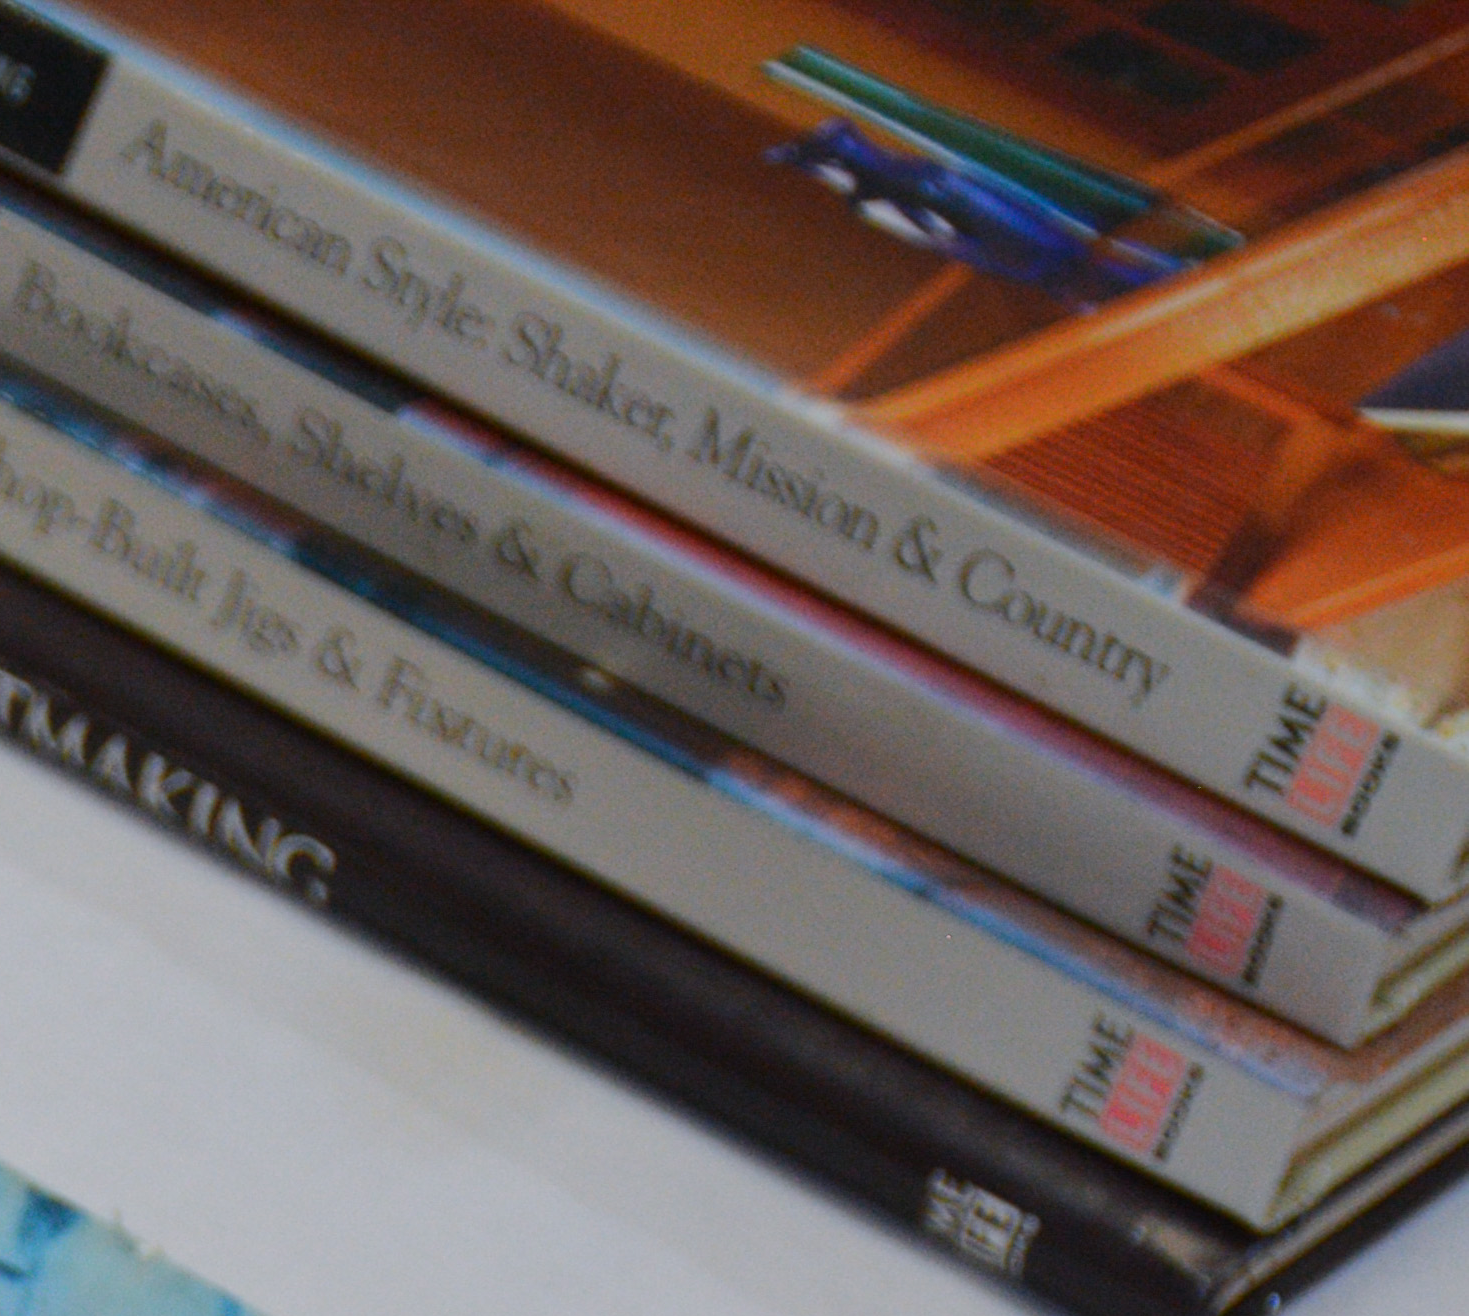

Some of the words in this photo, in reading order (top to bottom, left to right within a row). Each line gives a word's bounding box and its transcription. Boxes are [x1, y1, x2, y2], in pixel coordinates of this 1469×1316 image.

[118, 117, 355, 276] American
[688, 411, 882, 561] Mission
[891, 516, 940, 586] &
[953, 547, 1173, 715] Country
[285, 406, 481, 546] Shelves
[493, 520, 540, 584] &
[553, 539, 792, 712] Cabinets
[314, 628, 362, 692] &
[373, 656, 579, 806] Fixtures
[1245, 680, 1329, 798] TIME
[1290, 703, 1381, 828] LIFE
[1146, 845, 1215, 943] TIME
[1058, 1010, 1136, 1122] TIME
[1100, 1032, 1187, 1152] LIFE
